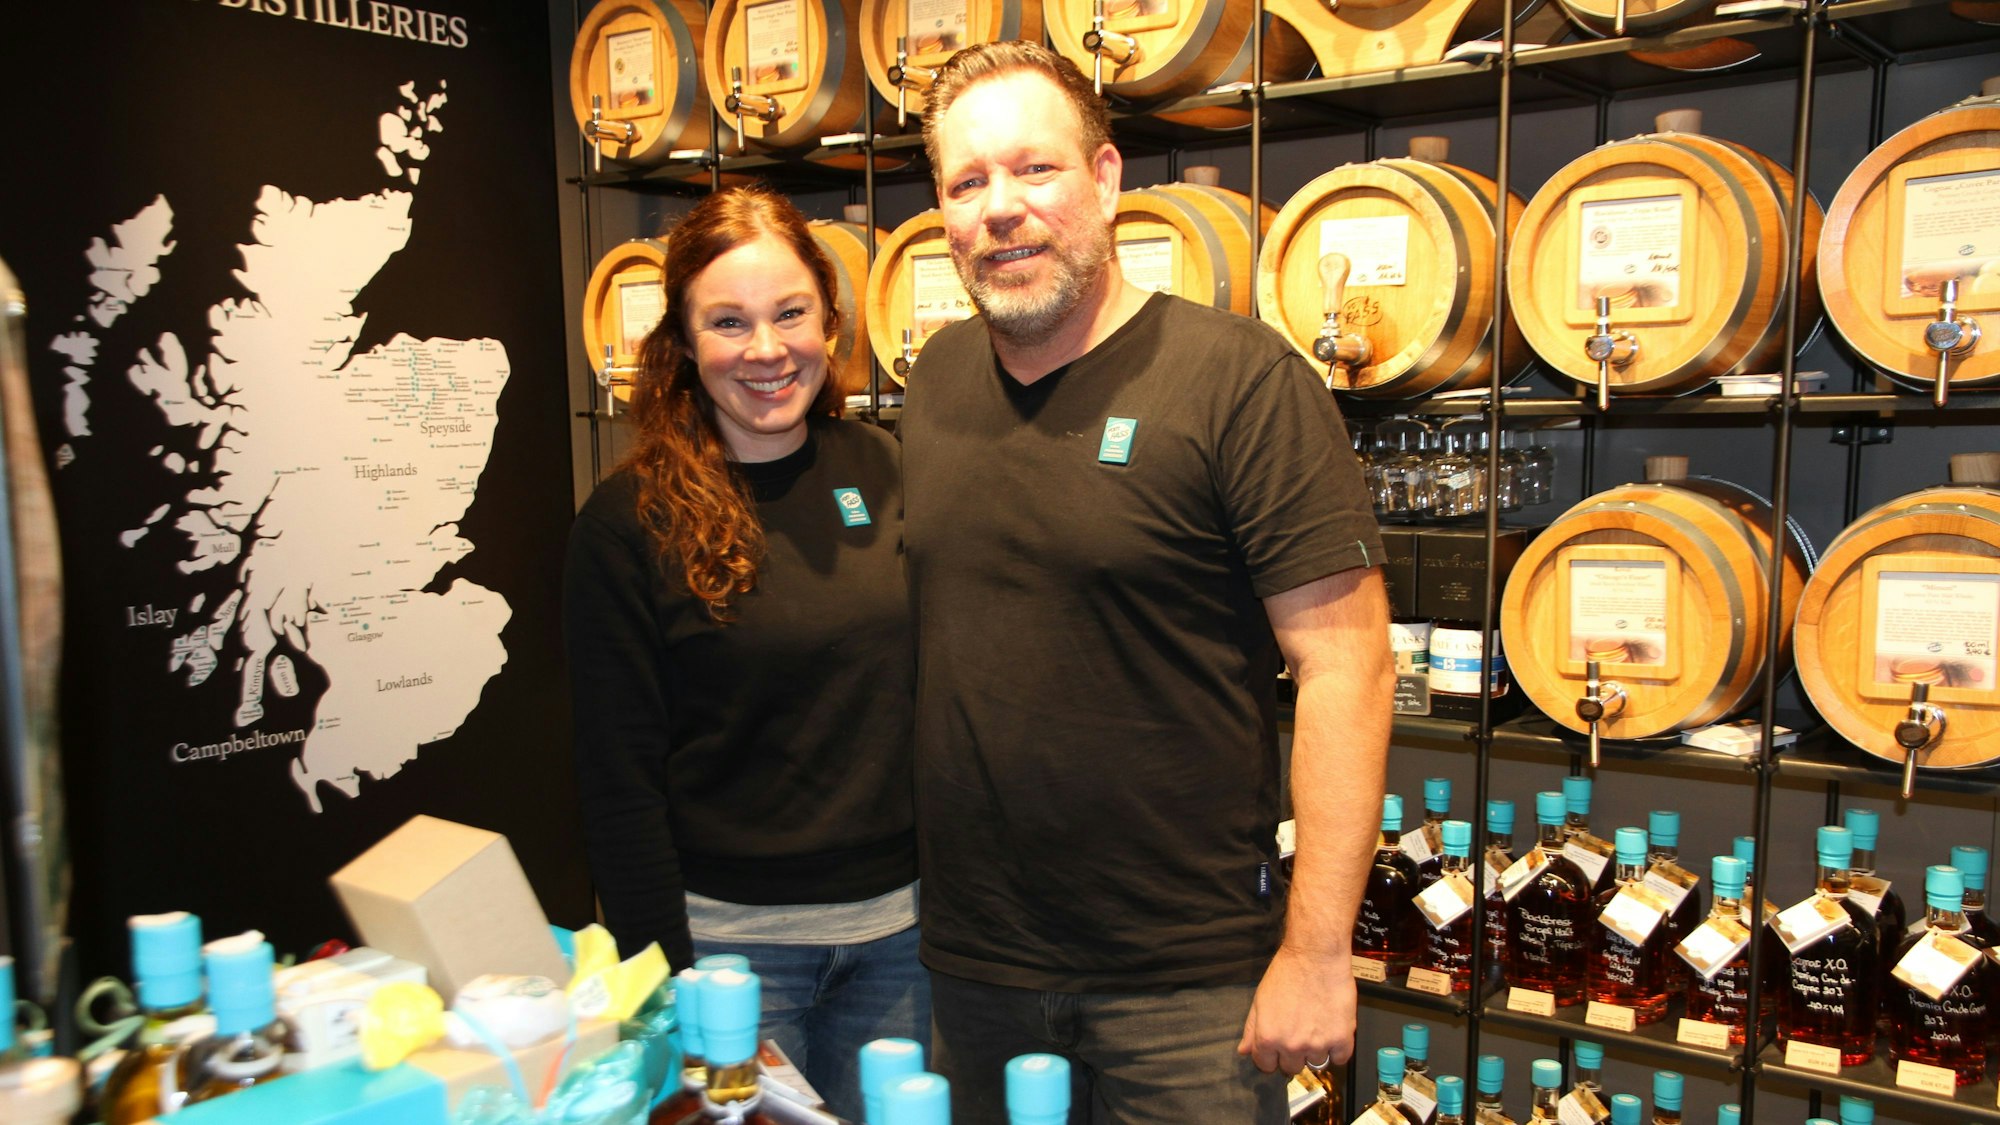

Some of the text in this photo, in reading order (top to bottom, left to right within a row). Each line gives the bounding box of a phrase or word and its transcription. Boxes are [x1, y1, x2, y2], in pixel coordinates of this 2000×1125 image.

[219, 0, 469, 48] STILLERIES
[420, 419, 472, 437] Speyside
[354, 463, 418, 481] Highlands
[212, 542, 235, 554] Mull
[127, 604, 178, 628] Islay
[347, 631, 383, 643] Glasgow
[250, 657, 263, 695] Kintyre
[377, 672, 433, 692] Lowlands
[172, 729, 306, 763] Campbeltown
